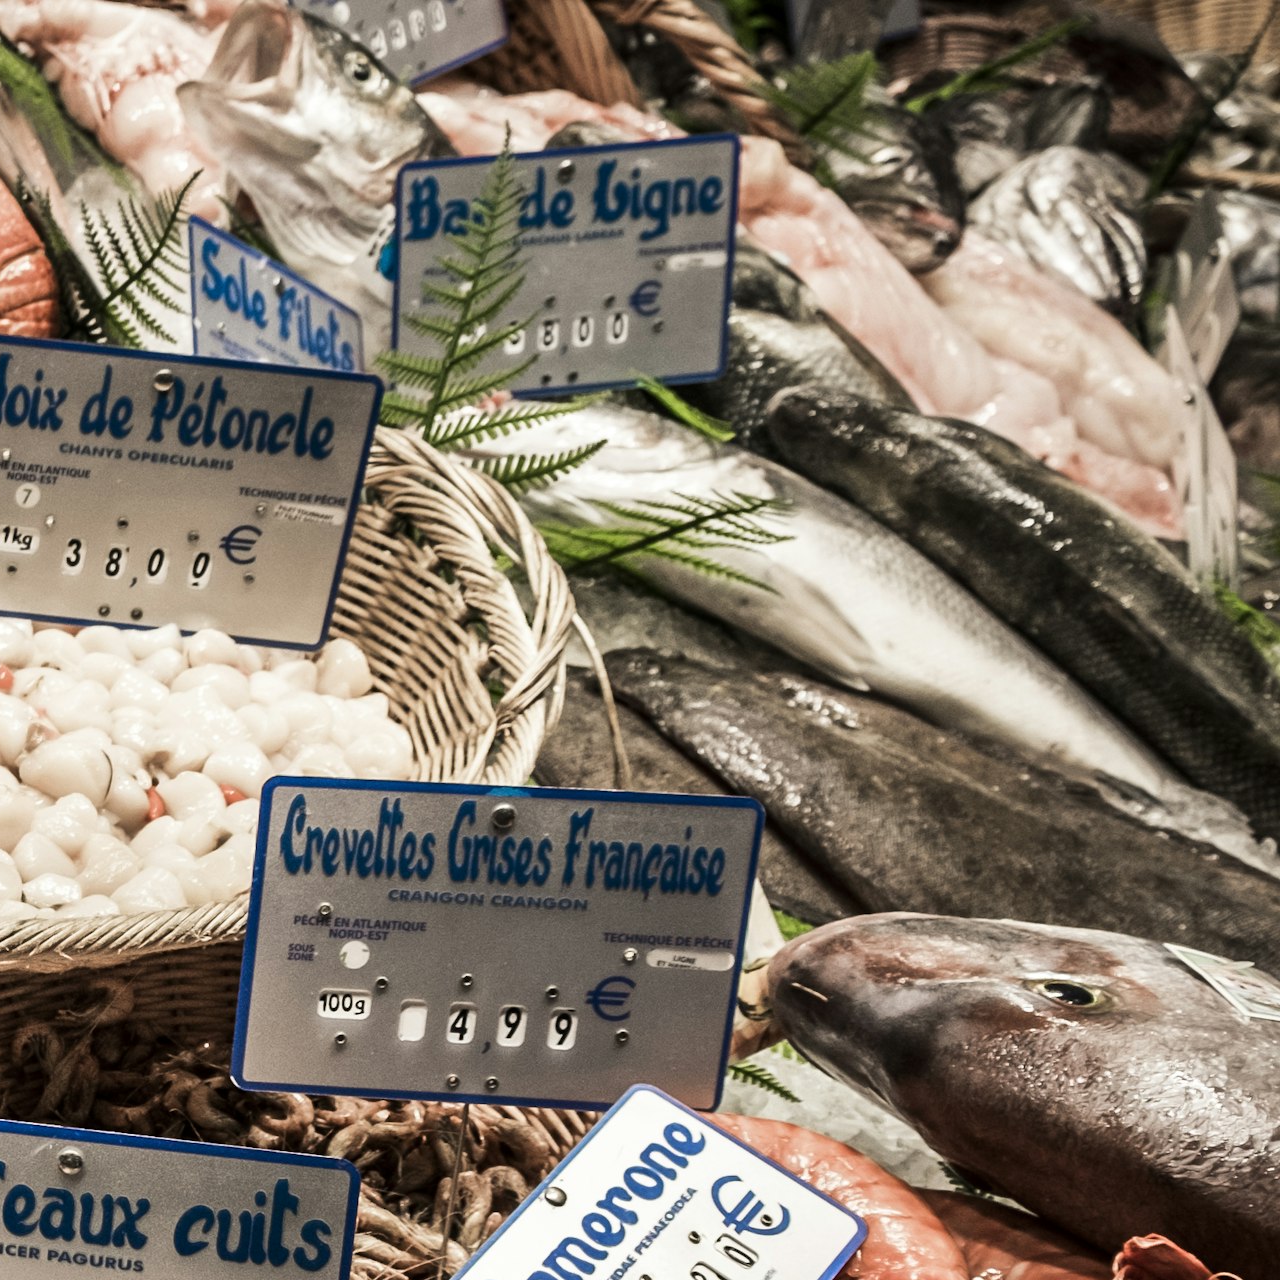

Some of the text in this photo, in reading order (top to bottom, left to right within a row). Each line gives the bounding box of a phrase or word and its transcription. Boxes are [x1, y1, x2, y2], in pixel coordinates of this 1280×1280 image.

[518, 166, 577, 229] de
[593, 159, 725, 242] Ligne
[202, 238, 268, 329] Sole
[278, 287, 354, 371] Filets
[79, 365, 134, 440] de
[147, 373, 336, 460] Pétoncle
[59, 443, 235, 471] CHANYS OPERCULARIS
[7, 472, 57, 486] NORD-EST
[11, 461, 26, 472] EN
[27, 463, 91, 479] ATLANTIQUE
[22, 489, 32, 504] 7
[239, 486, 297, 501] TECHNIQUE
[299, 493, 313, 503] DE
[2, 525, 32, 551] 1kg
[280, 793, 726, 901] Crevettes Grises Française
[388, 889, 588, 911] CRANGON CRANGON
[293, 914, 428, 932] PÊCHE EN ATLANTIQUE
[329, 928, 389, 942] NORD-EST
[604, 932, 734, 949] TECHNIQUE DE PÊCHE
[287, 952, 314, 962] ZONE
[288, 943, 315, 953] SOUS
[673, 955, 697, 965] LIGNE
[319, 993, 366, 1016] 100g
[172, 1177, 333, 1272] cuits
[635, 1187, 698, 1256] PENAEOIDEA
[47, 1249, 145, 1272] PAGURUS
